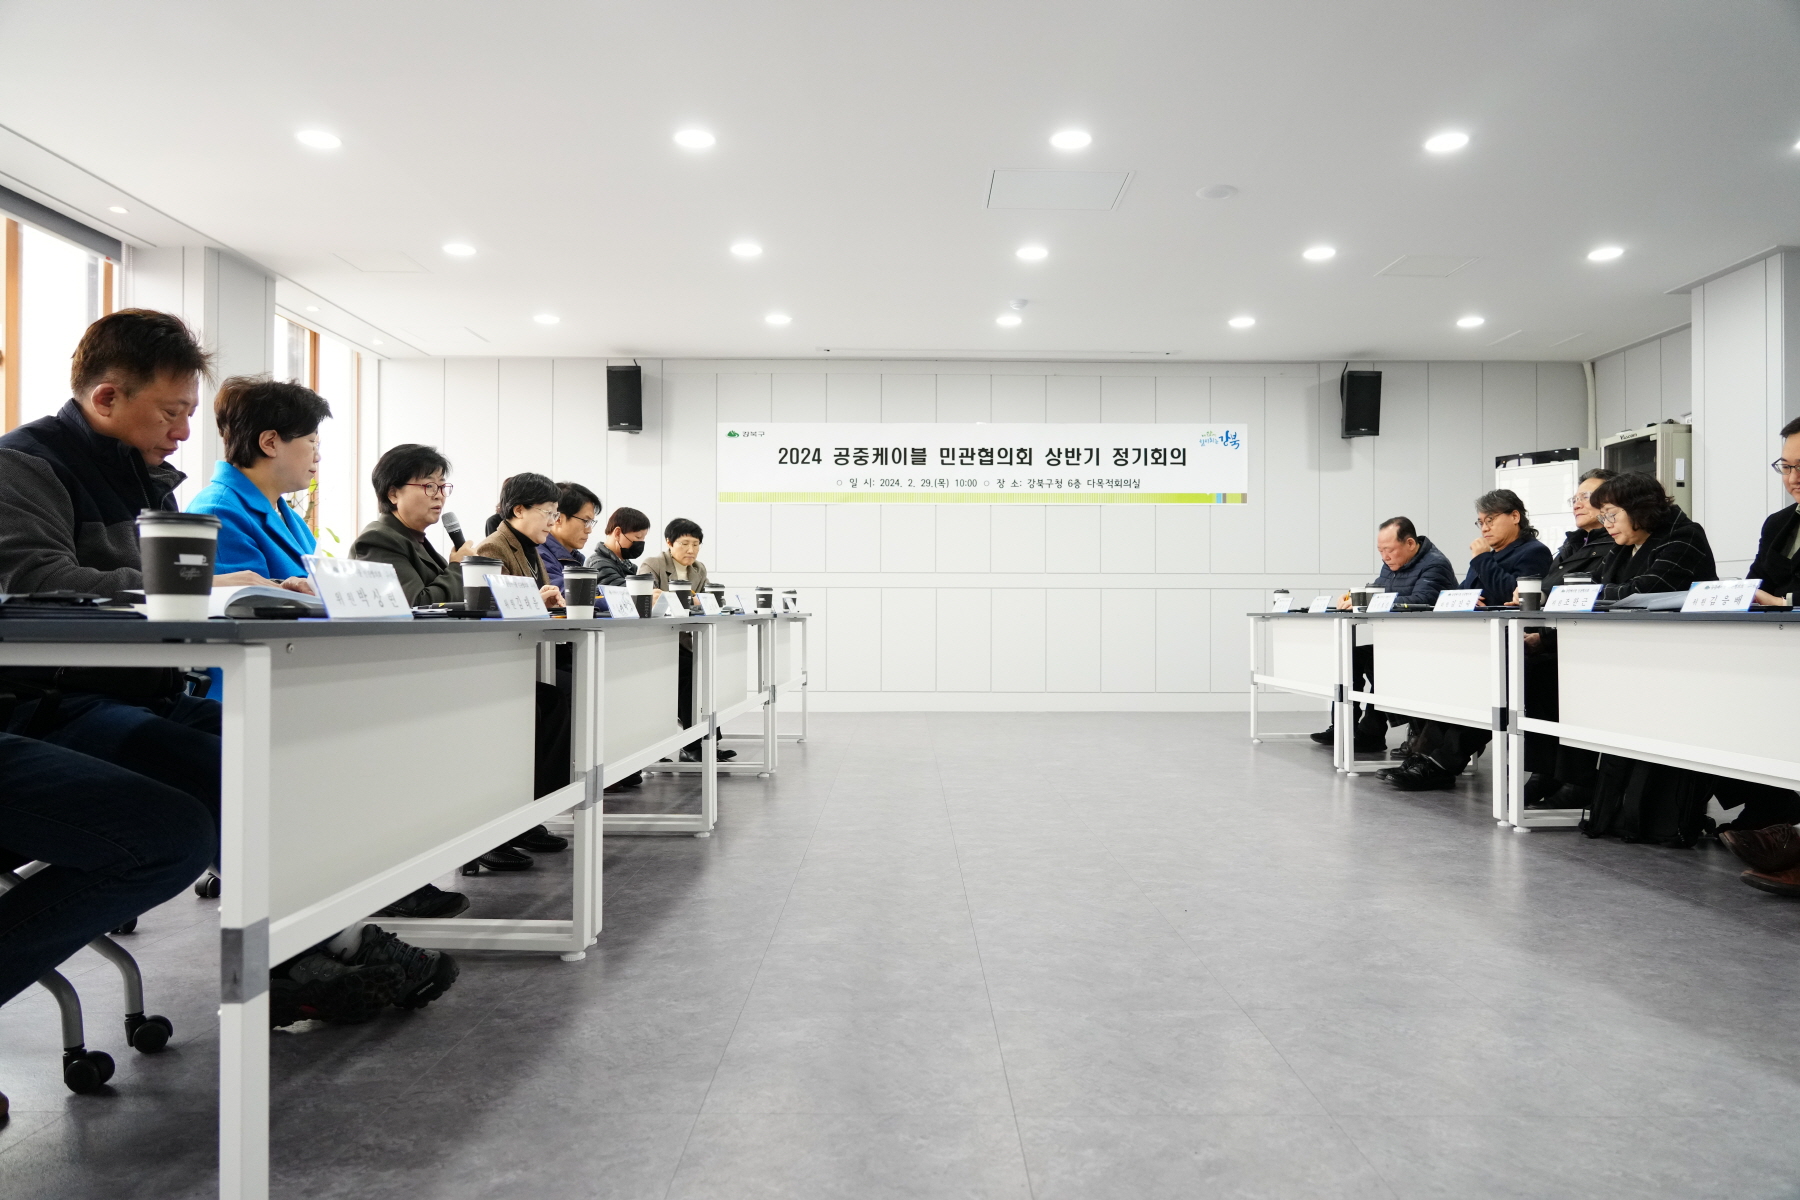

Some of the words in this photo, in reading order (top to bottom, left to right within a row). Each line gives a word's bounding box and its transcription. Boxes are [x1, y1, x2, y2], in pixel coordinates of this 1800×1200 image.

[1219, 429, 1240, 450] 강북
[778, 447, 823, 465] 2024
[833, 447, 928, 466] 공중케이블
[939, 447, 1033, 467] 민관협의회
[1045, 447, 1100, 467] 상반기
[1112, 447, 1187, 467] 정기회의
[849, 478, 858, 489] 일
[863, 478, 875, 488] 시:
[879, 478, 903, 489] 2024.
[907, 478, 916, 488] 2.
[920, 478, 950, 489] 29.(목)
[954, 478, 978, 488] 10:00
[996, 478, 1006, 489] 장
[1010, 478, 1023, 488] 소:
[1027, 478, 1063, 490] 강북구청
[1067, 478, 1082, 490] 6층
[1086, 478, 1141, 490] 다목적회의실
